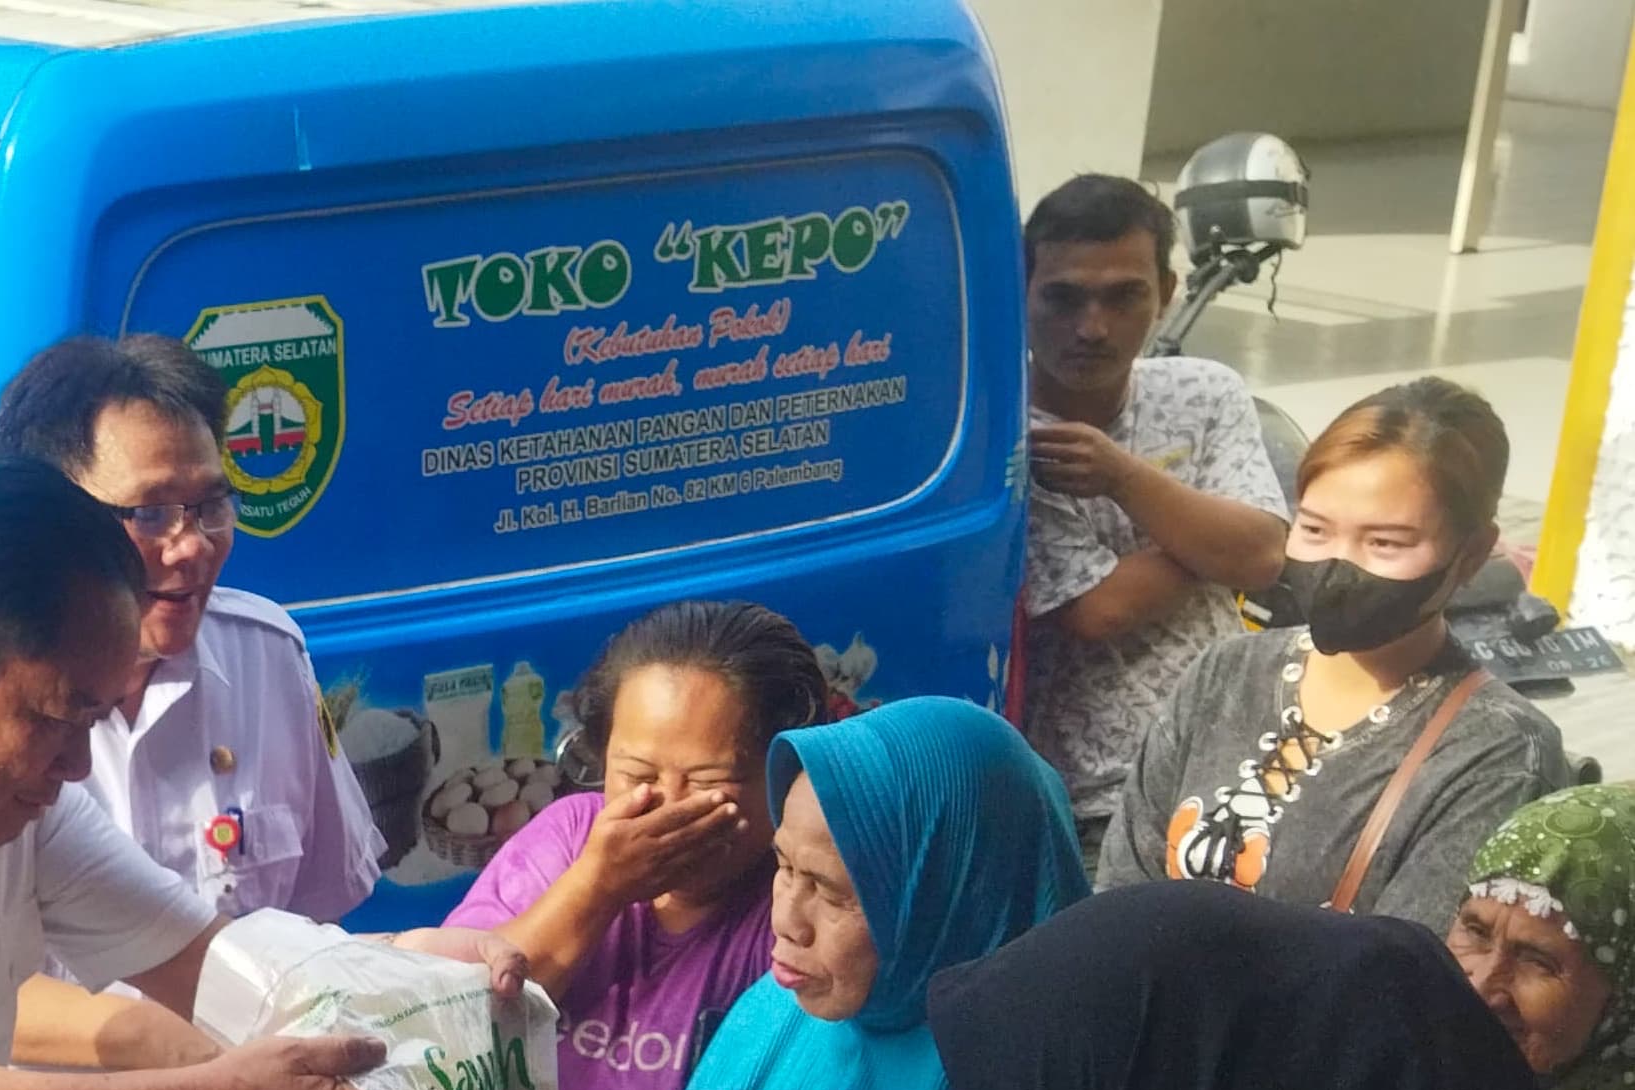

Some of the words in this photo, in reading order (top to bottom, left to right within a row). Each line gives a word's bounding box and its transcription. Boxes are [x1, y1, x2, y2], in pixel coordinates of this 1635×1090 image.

[422, 239, 631, 327] TOKO
[197, 346, 270, 370] UMATERA
[273, 338, 337, 363] SELATAN
[442, 389, 534, 429] Setiap
[539, 375, 596, 413] hari
[693, 344, 770, 390] murah
[772, 342, 840, 380] setiap
[843, 329, 892, 366] hari
[422, 441, 494, 477] DINAS
[498, 419, 633, 466] KETAHANAN
[637, 403, 726, 444] PANGAN
[729, 398, 773, 428] DAN
[776, 376, 907, 420] PETERNAKAN
[516, 454, 621, 494] PROVINSI
[623, 435, 737, 478] SUMATERA
[740, 419, 831, 456] SELATAN
[494, 509, 517, 534] Jl.
[521, 503, 558, 529] Kol.
[561, 500, 581, 523] H.
[584, 490, 647, 519] Barlian
[651, 484, 683, 508] No.
[684, 478, 707, 502] 82
[708, 473, 737, 498] KM
[739, 471, 753, 493] 6
[753, 458, 843, 490] Palembang
